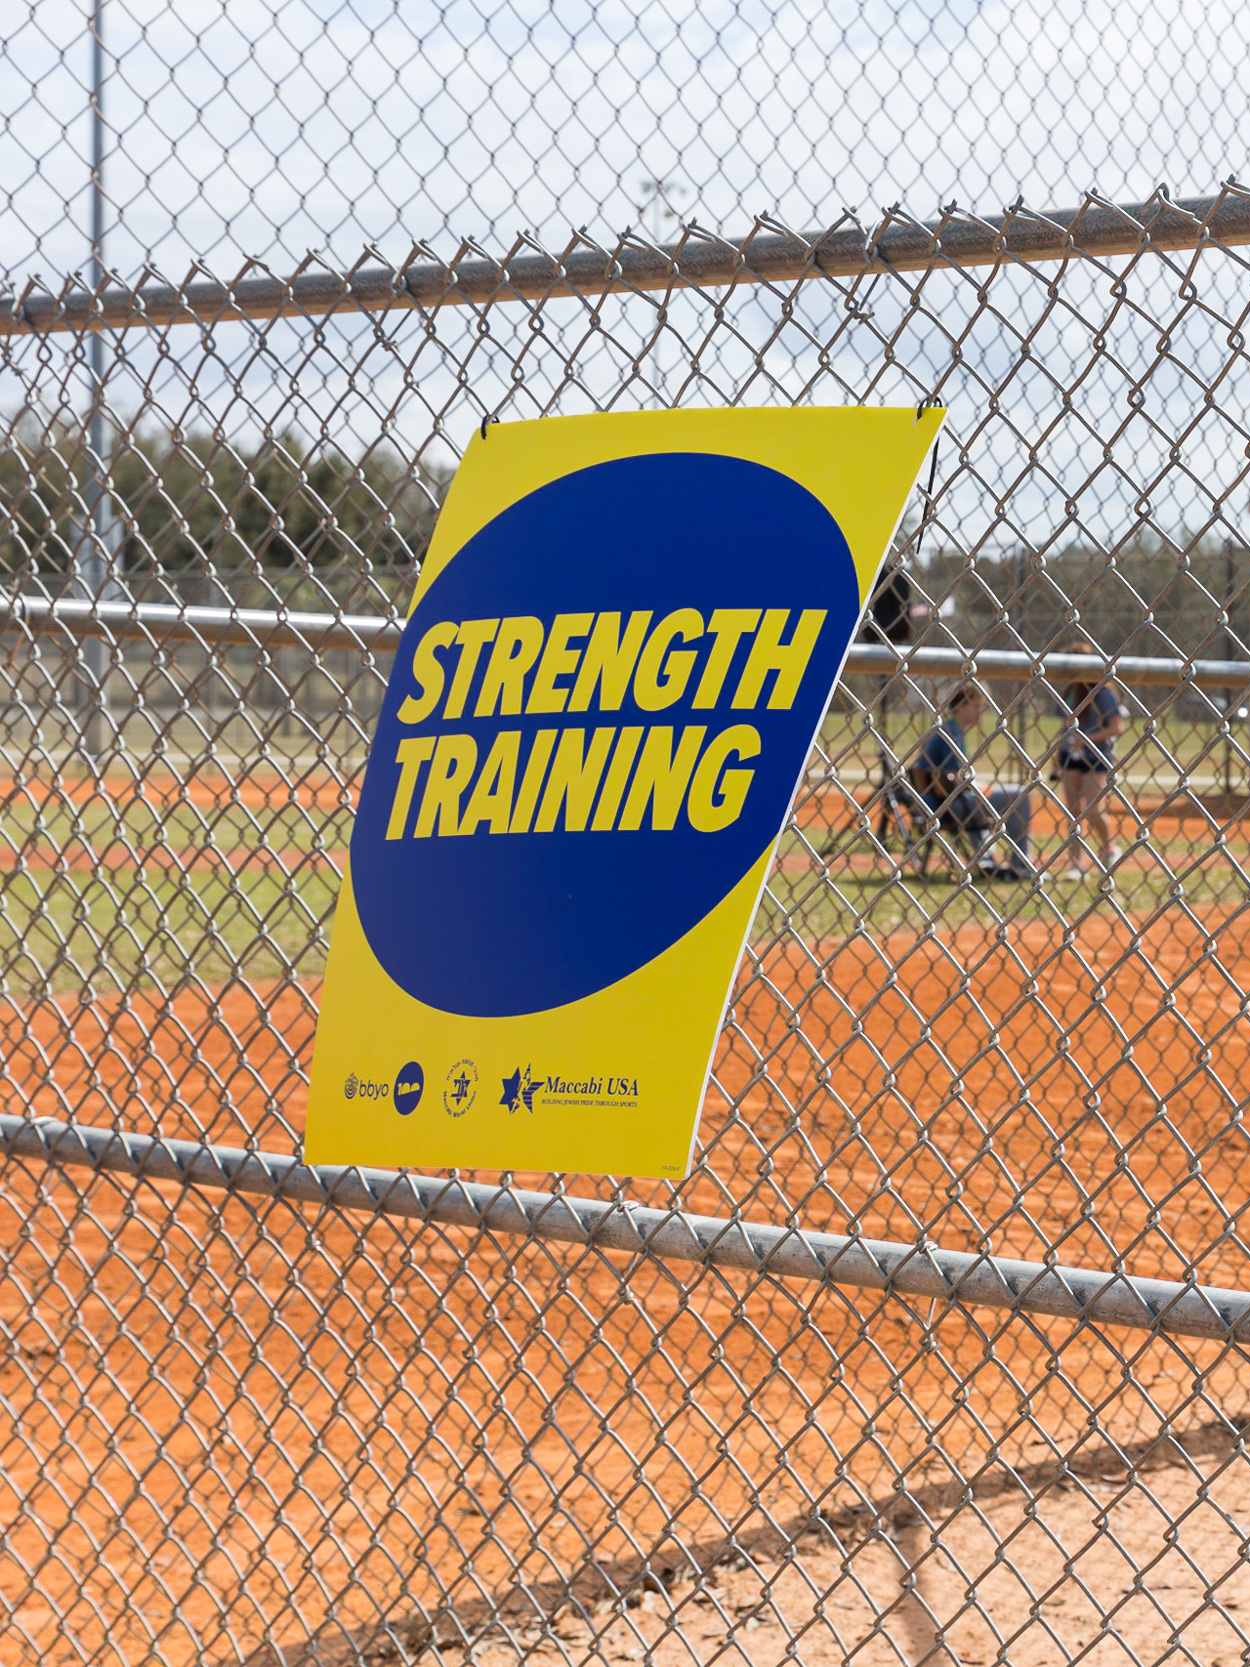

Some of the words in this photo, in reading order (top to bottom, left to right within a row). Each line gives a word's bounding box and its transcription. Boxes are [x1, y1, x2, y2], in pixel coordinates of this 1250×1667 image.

[397, 608, 828, 724] STRENGTH
[385, 725, 761, 840] TRAINING
[359, 1080, 389, 1100] bbyo
[544, 1076, 603, 1094] Maccabi
[607, 1077, 639, 1096] USA
